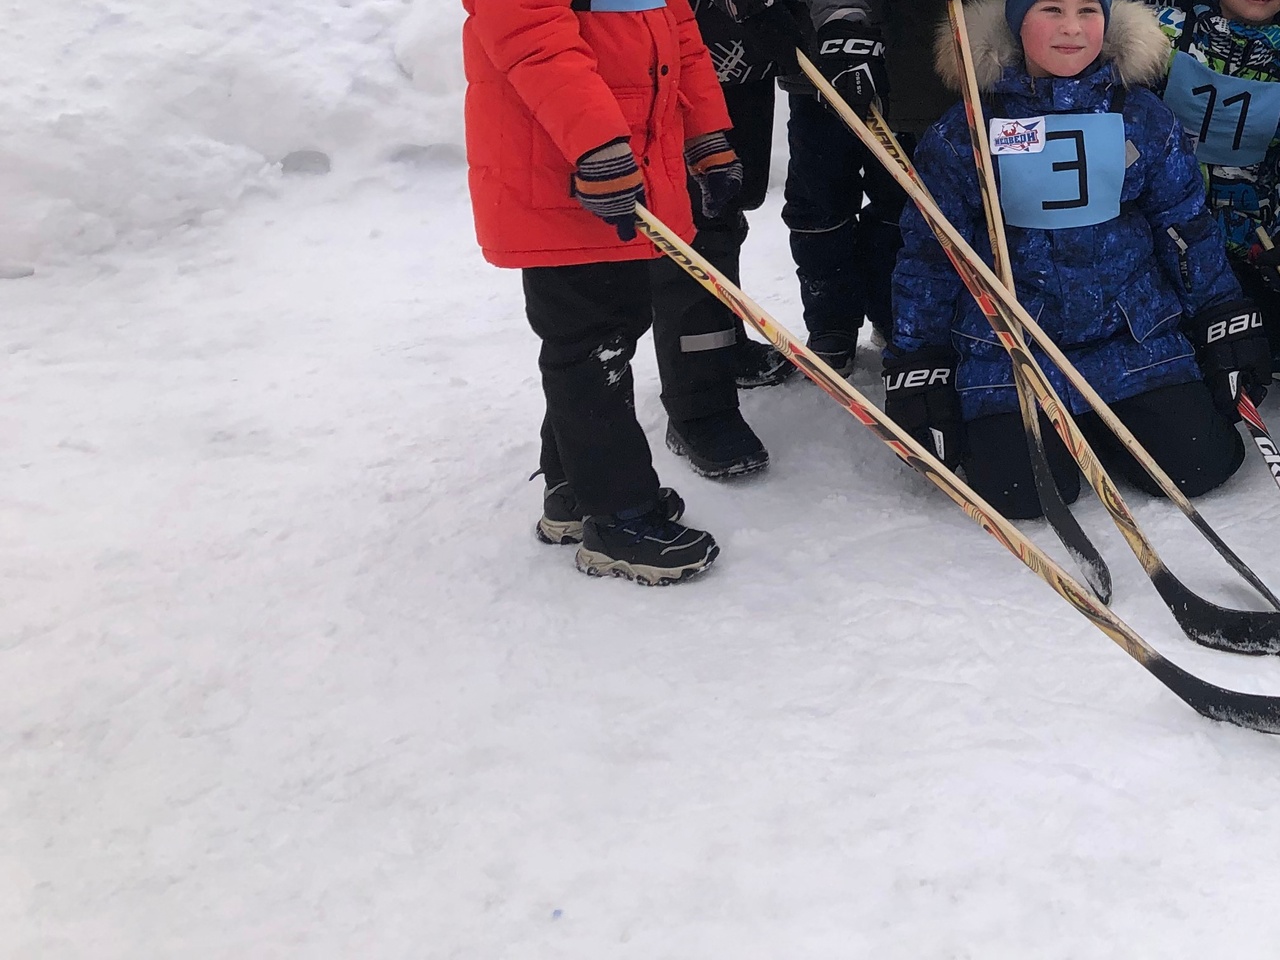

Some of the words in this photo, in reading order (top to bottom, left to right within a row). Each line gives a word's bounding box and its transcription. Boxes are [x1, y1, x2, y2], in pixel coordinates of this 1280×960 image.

[820, 38, 886, 57] CCM
[1191, 83, 1252, 151] 11
[1042, 129, 1089, 211] 3
[883, 367, 951, 391] UER
